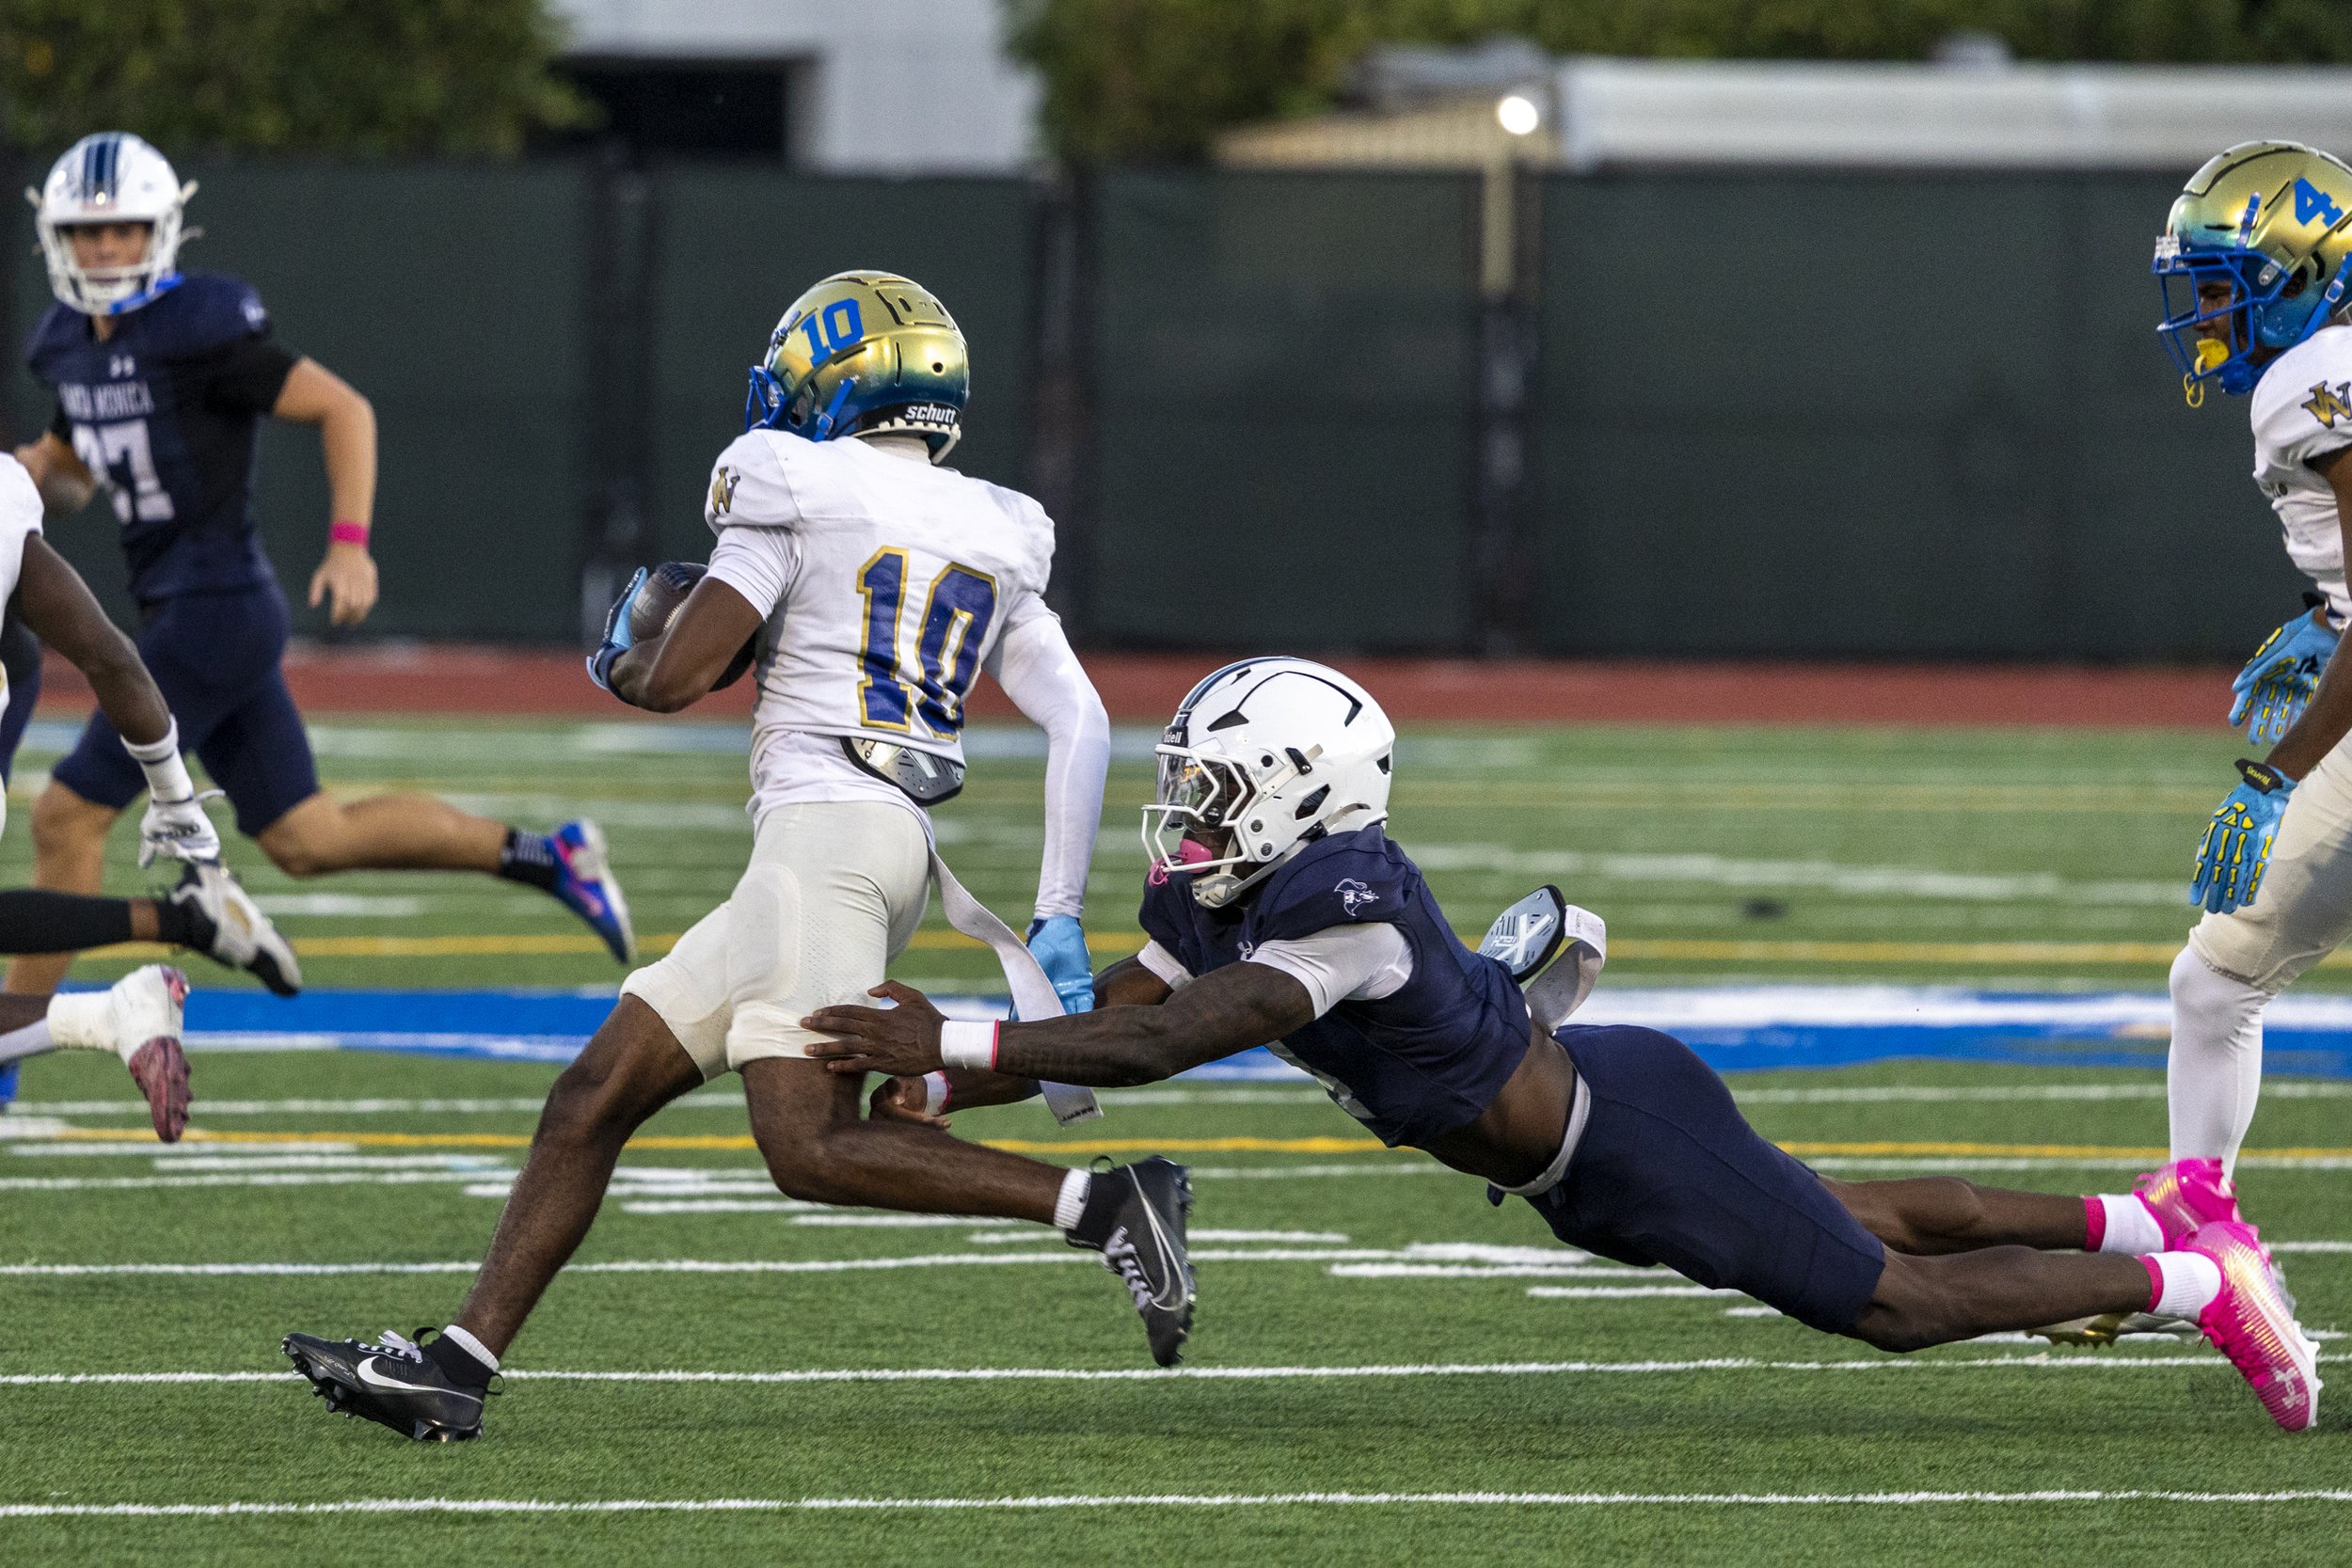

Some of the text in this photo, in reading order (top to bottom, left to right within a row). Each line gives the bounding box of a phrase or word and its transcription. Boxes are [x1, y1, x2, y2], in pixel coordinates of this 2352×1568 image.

[2294, 177, 2344, 228] 4
[801, 298, 865, 368] 10
[904, 403, 957, 424] schutt
[856, 546, 997, 743] 10
